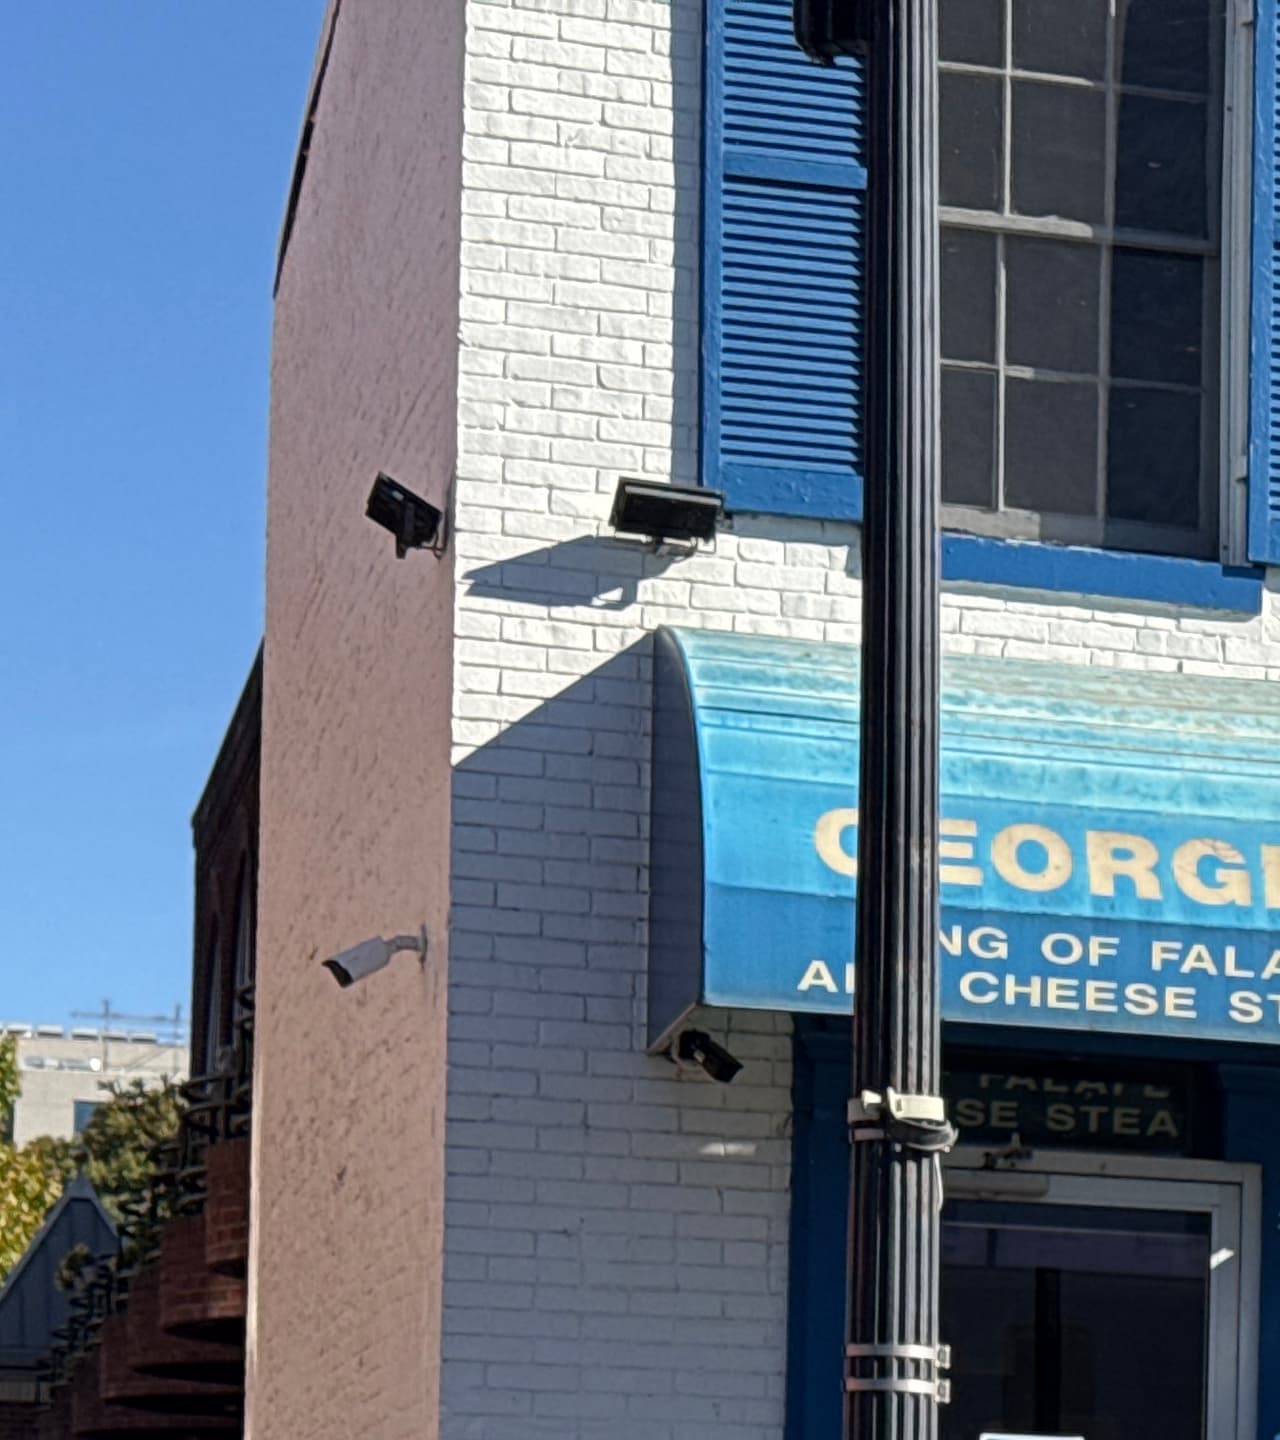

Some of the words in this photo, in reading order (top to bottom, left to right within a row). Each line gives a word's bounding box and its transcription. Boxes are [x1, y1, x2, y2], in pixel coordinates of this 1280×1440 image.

[939, 925, 1009, 960] NG
[1041, 933, 1120, 967] OF
[960, 971, 1197, 1019] CHEESE
